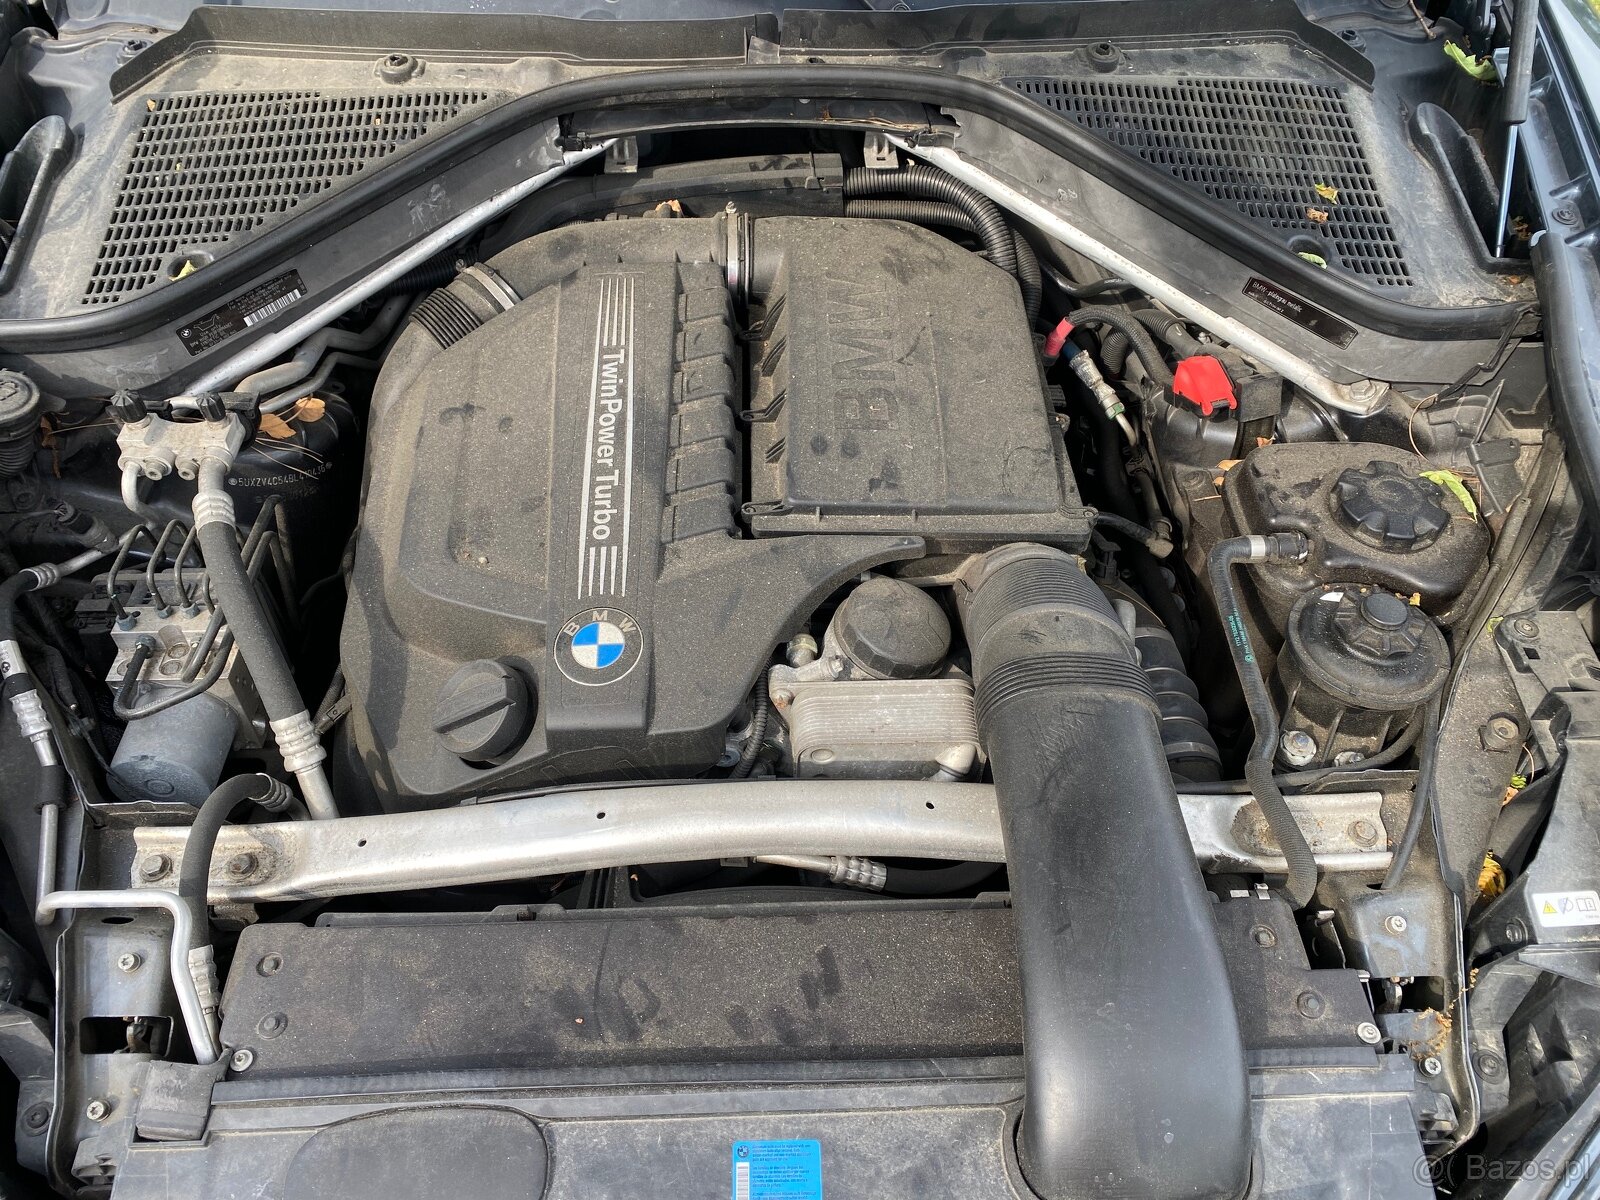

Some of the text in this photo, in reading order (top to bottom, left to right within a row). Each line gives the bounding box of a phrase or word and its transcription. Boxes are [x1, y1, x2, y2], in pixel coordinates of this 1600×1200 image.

[825, 271, 900, 431] BMW
[592, 348, 624, 540] TwinPower Turbo
[564, 609, 637, 637] BMW
